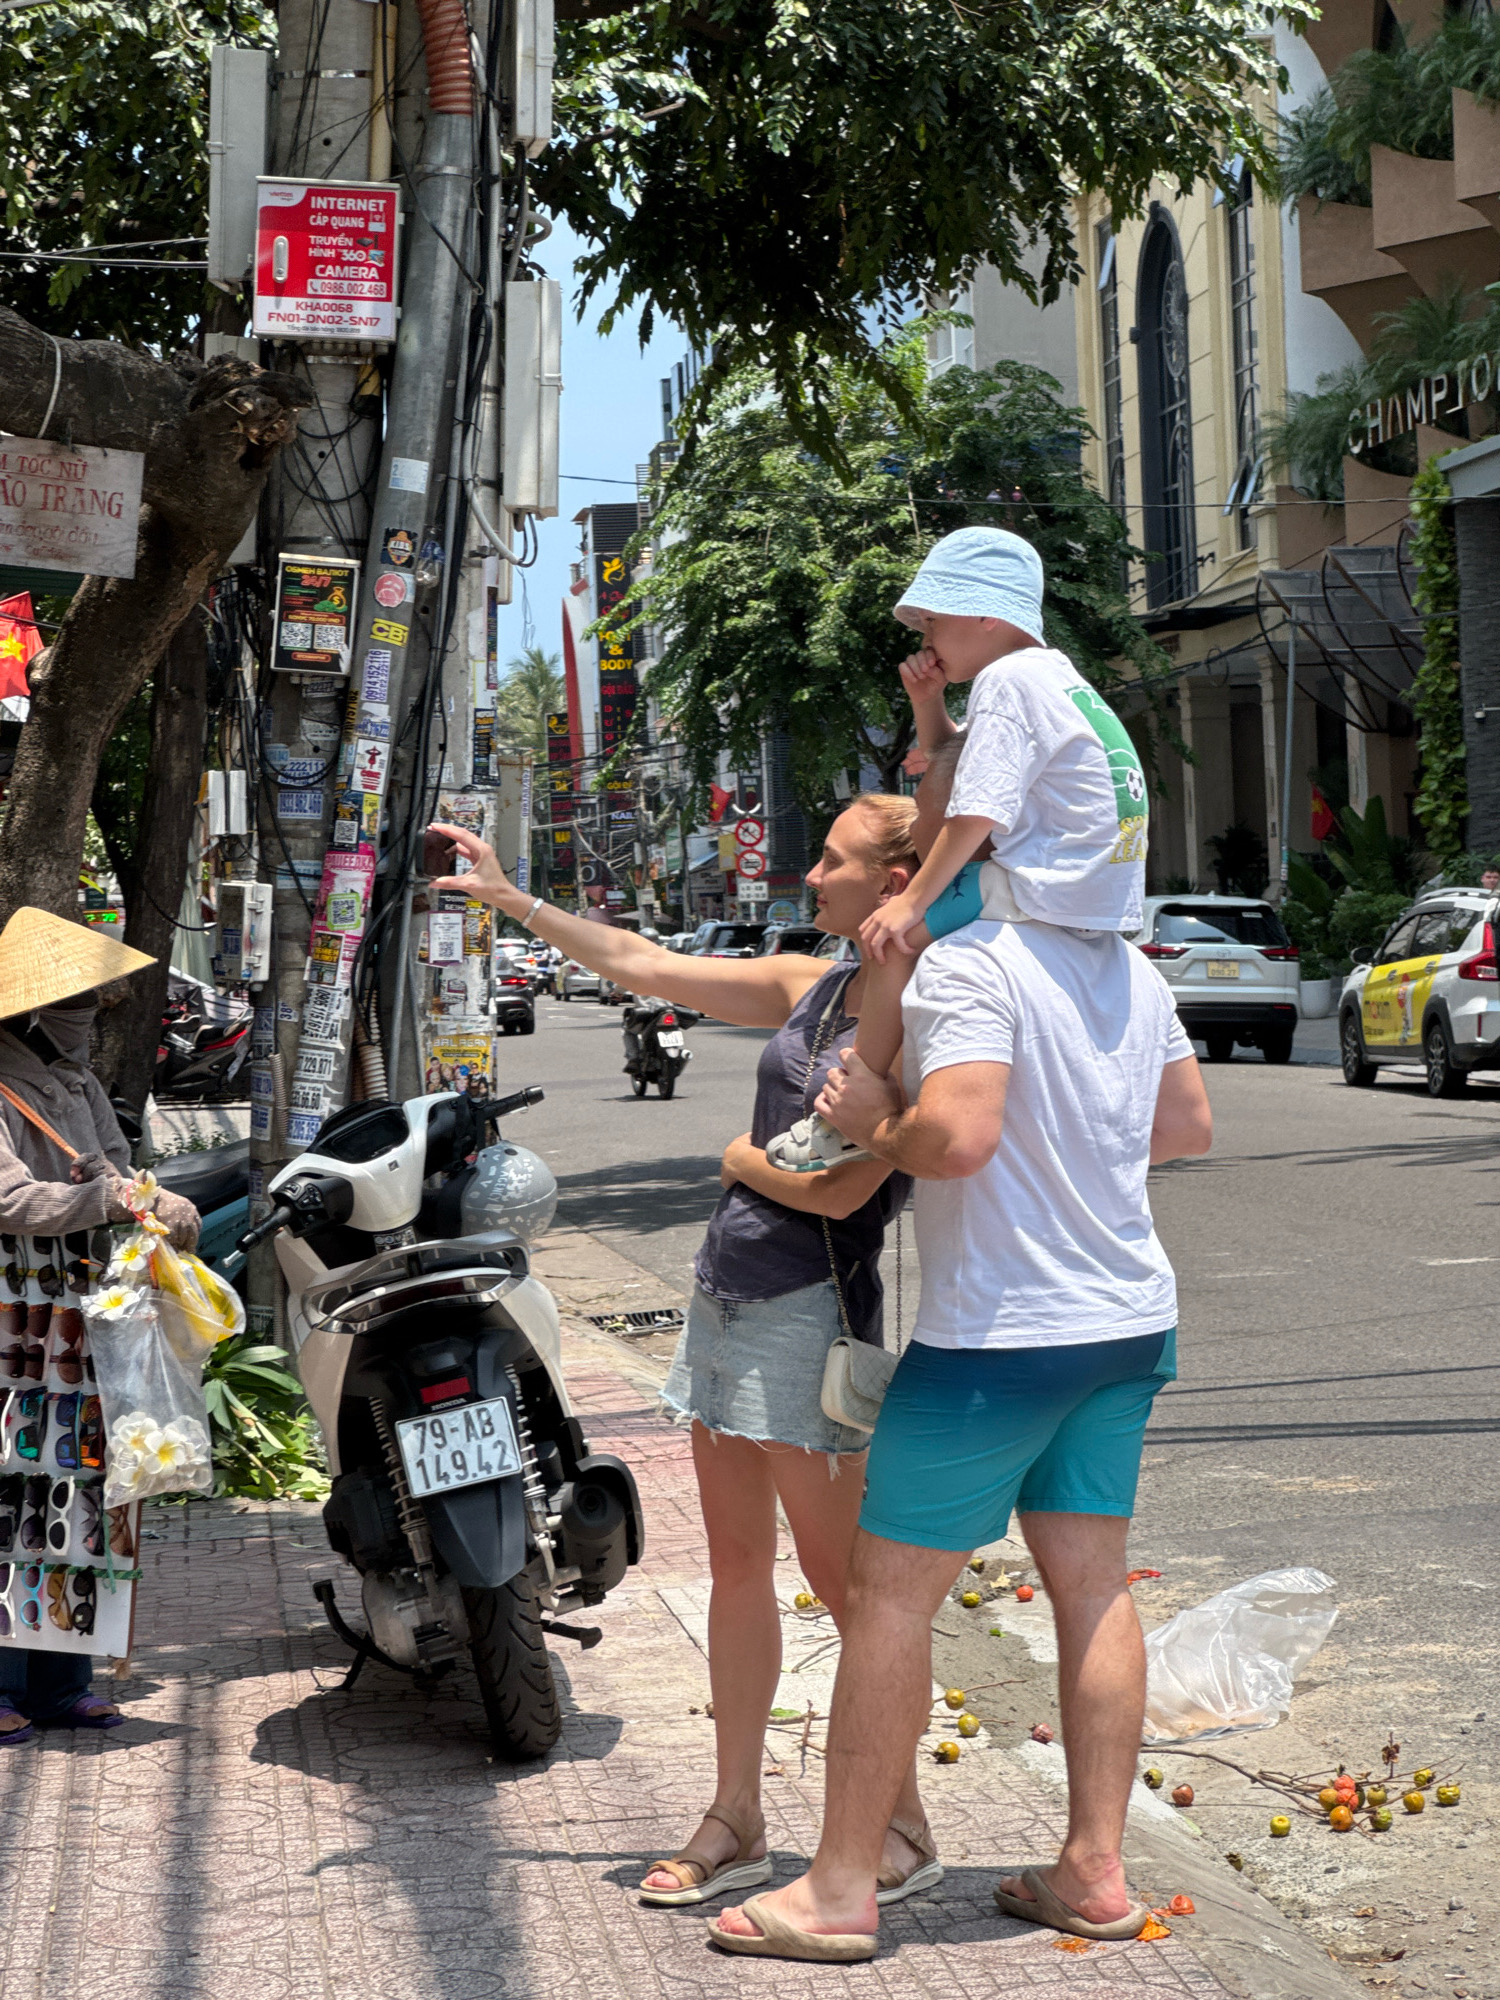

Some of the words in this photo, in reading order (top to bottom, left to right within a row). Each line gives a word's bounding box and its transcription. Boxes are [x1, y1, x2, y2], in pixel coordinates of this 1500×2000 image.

[310, 196, 387, 212] INTERNET
[331, 215, 365, 230] QUANG
[315, 264, 380, 280] CAMERA
[320, 281, 385, 296] 0986.002.468
[267, 312, 381, 327] FN01-DN02-SN17
[1349, 353, 1500, 454] CHAMPIO
[40, 483, 124, 519] TRANG
[301, 574, 331, 588] 24/7
[608, 645, 624, 656] &
[600, 659, 634, 671] BODY
[431, 1398, 467, 1411] HONDA
[413, 1407, 495, 1455] 79-AB
[416, 1440, 513, 1490] 149.42
